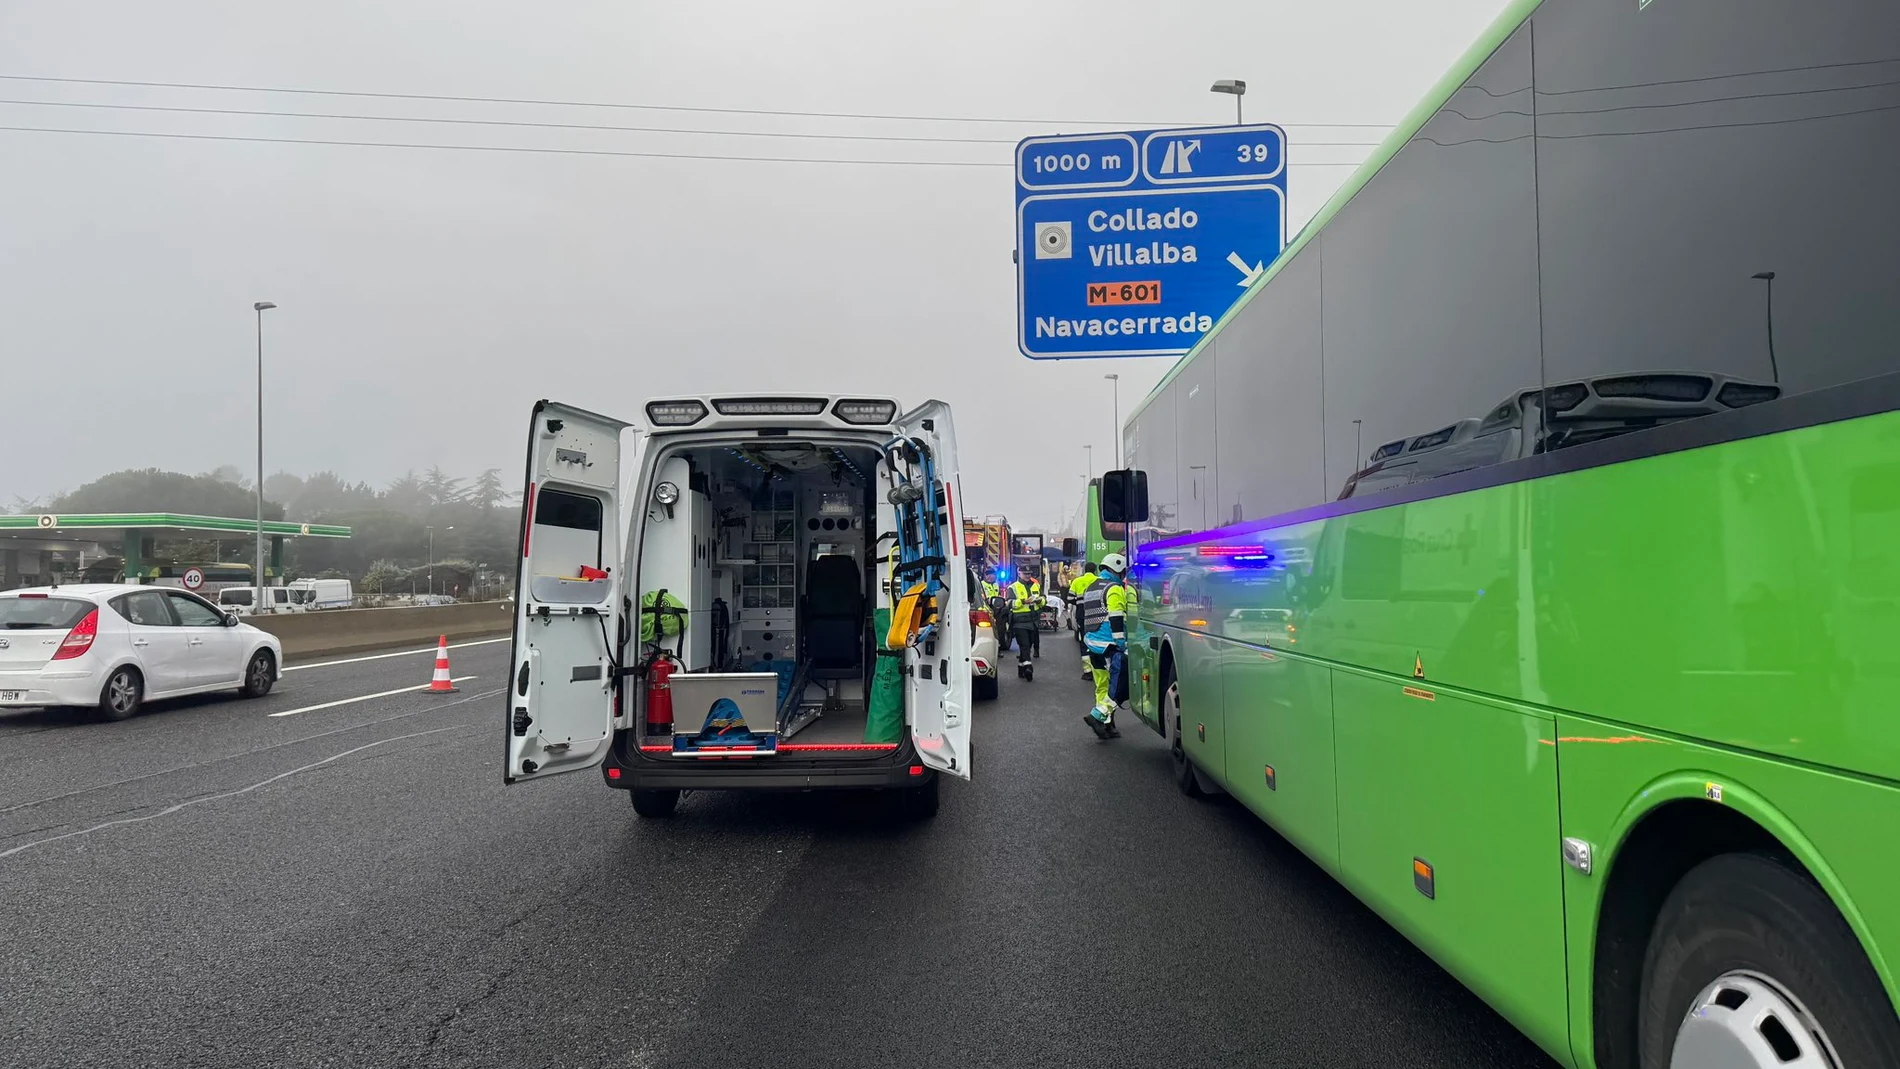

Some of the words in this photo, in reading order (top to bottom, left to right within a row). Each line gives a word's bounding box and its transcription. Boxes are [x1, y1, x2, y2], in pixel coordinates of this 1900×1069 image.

[1033, 153, 1090, 173] 1000
[1101, 155, 1121, 169] m
[1237, 144, 1268, 163] 39
[1087, 207, 1198, 232] Collado
[1088, 242, 1198, 267] Villalba
[1089, 284, 1159, 303] M-601
[1035, 311, 1213, 338] Navacerrada
[1092, 542, 1107, 551] 155
[186, 575, 200, 583] 40
